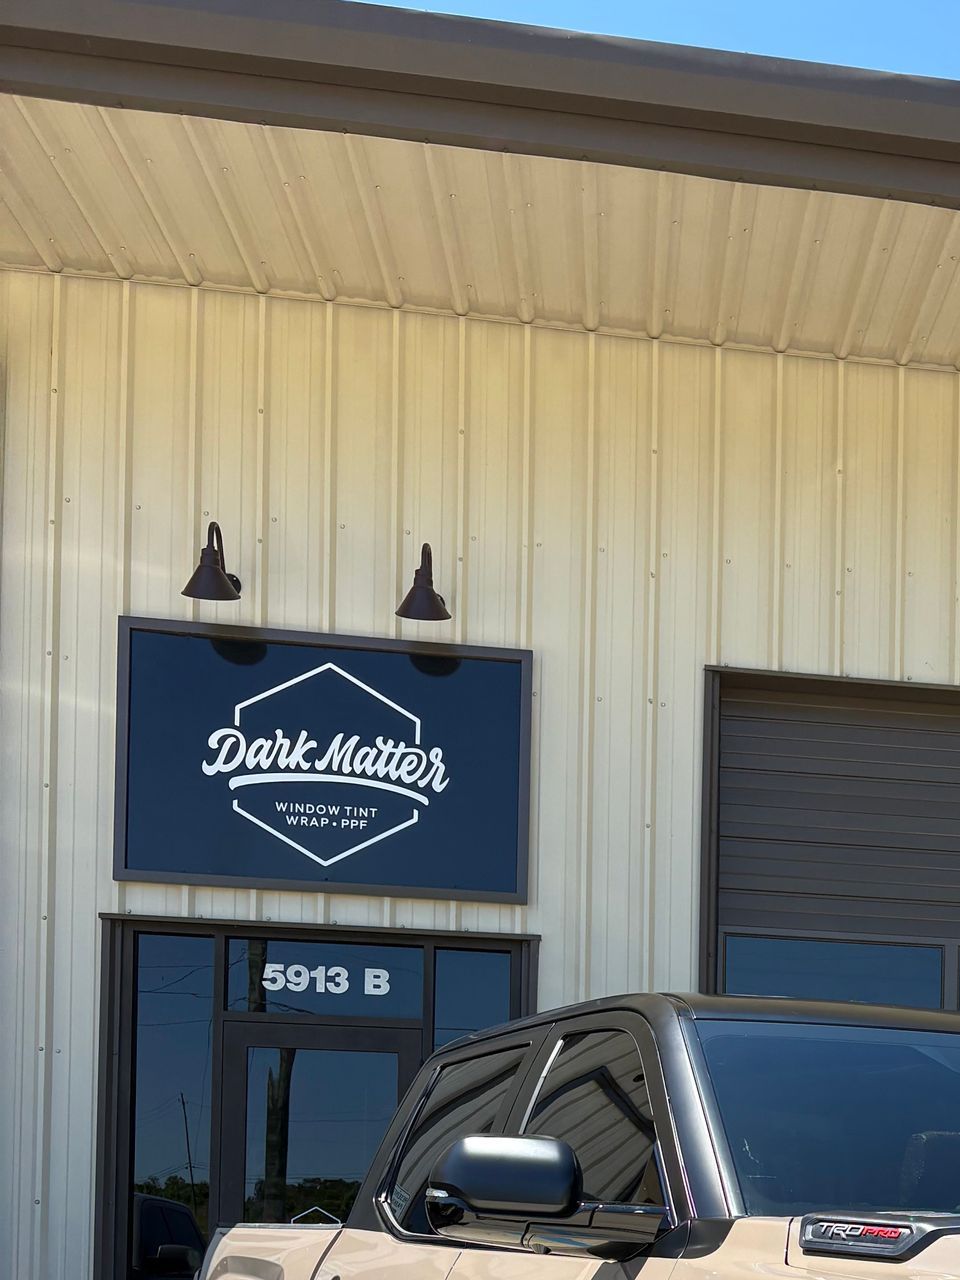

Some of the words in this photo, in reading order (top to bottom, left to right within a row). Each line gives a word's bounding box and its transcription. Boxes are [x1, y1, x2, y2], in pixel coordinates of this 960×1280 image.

[201, 727, 318, 776] Dark
[314, 732, 450, 793] Matter
[275, 801, 341, 815] WINDOW
[344, 806, 378, 818] TINT
[285, 815, 329, 827] WRAP
[341, 818, 368, 830] PPF
[261, 963, 350, 994] 5913
[364, 968, 391, 995] B
